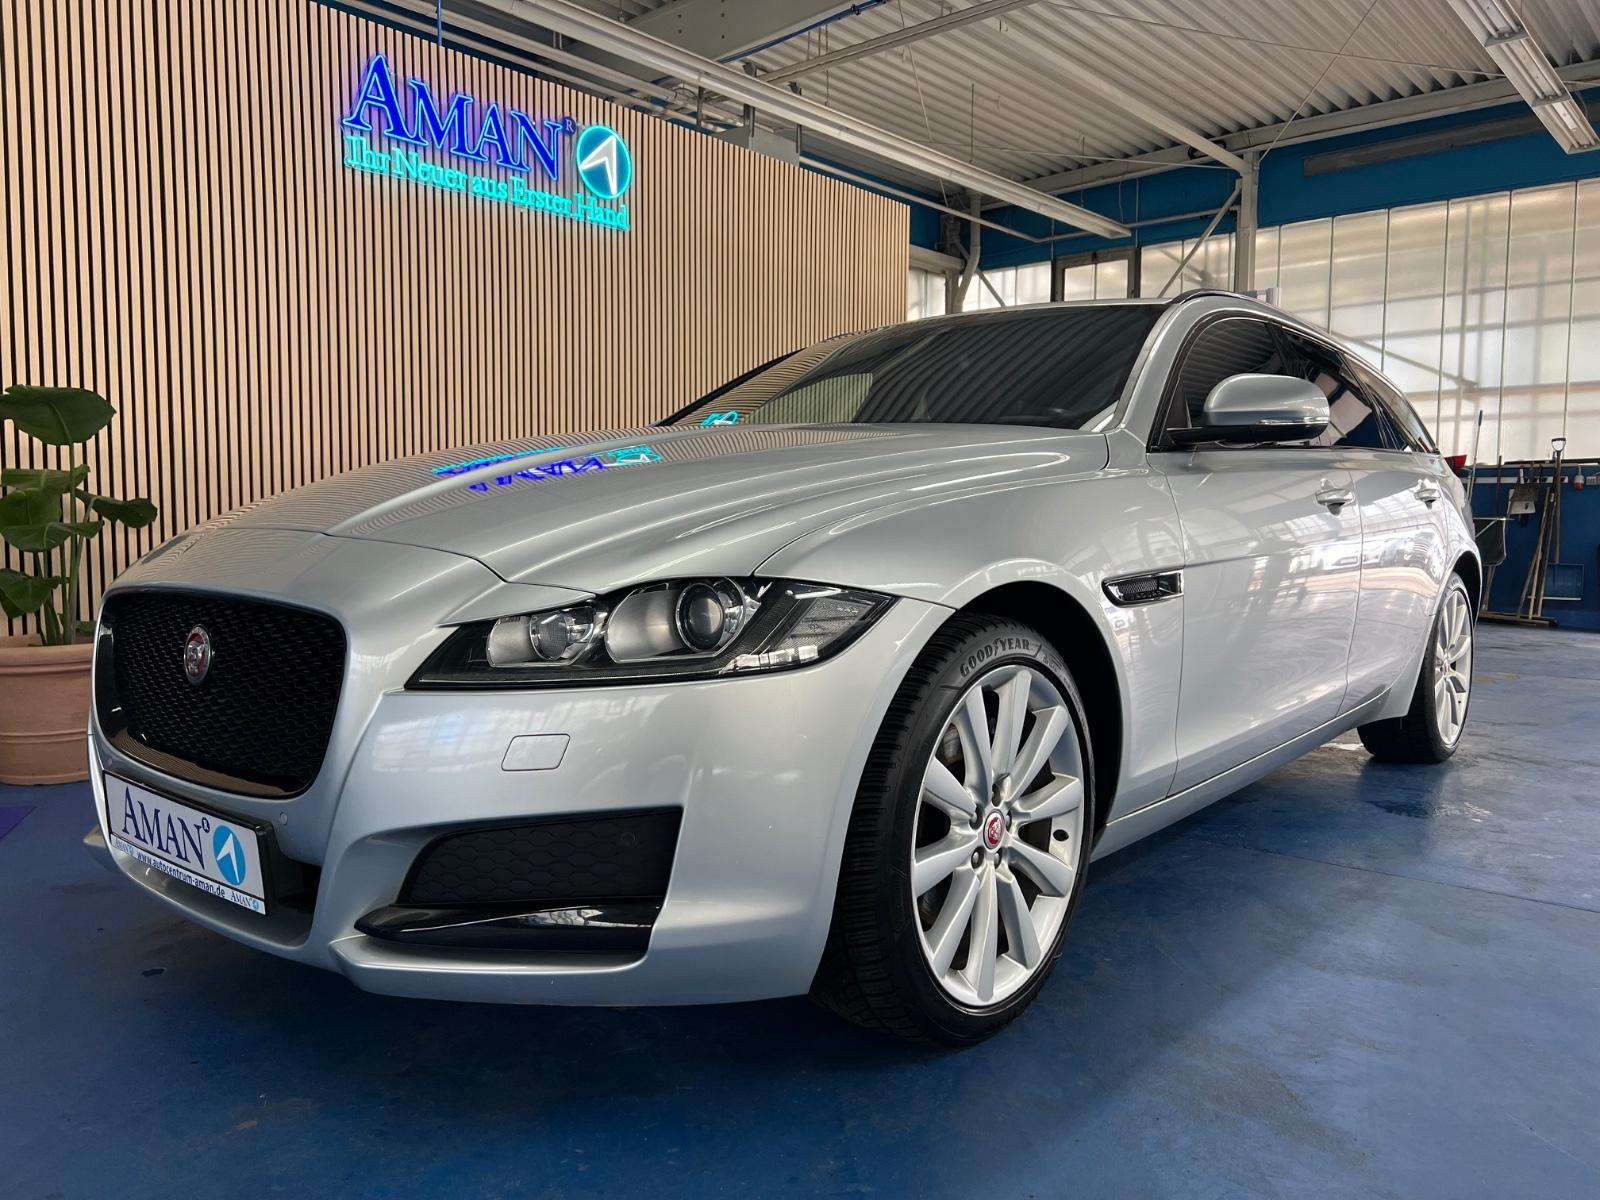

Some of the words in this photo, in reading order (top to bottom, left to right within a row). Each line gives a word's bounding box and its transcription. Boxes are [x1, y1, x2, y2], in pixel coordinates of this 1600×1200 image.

[344, 135, 391, 172] Ihr
[391, 146, 468, 190] Neuer
[472, 176, 508, 201] aus
[510, 175, 572, 213] Erster
[574, 192, 630, 230] Hand
[959, 637, 1030, 678] GOODYEAR
[136, 851, 225, 898] www.autocentrum-aman.de
